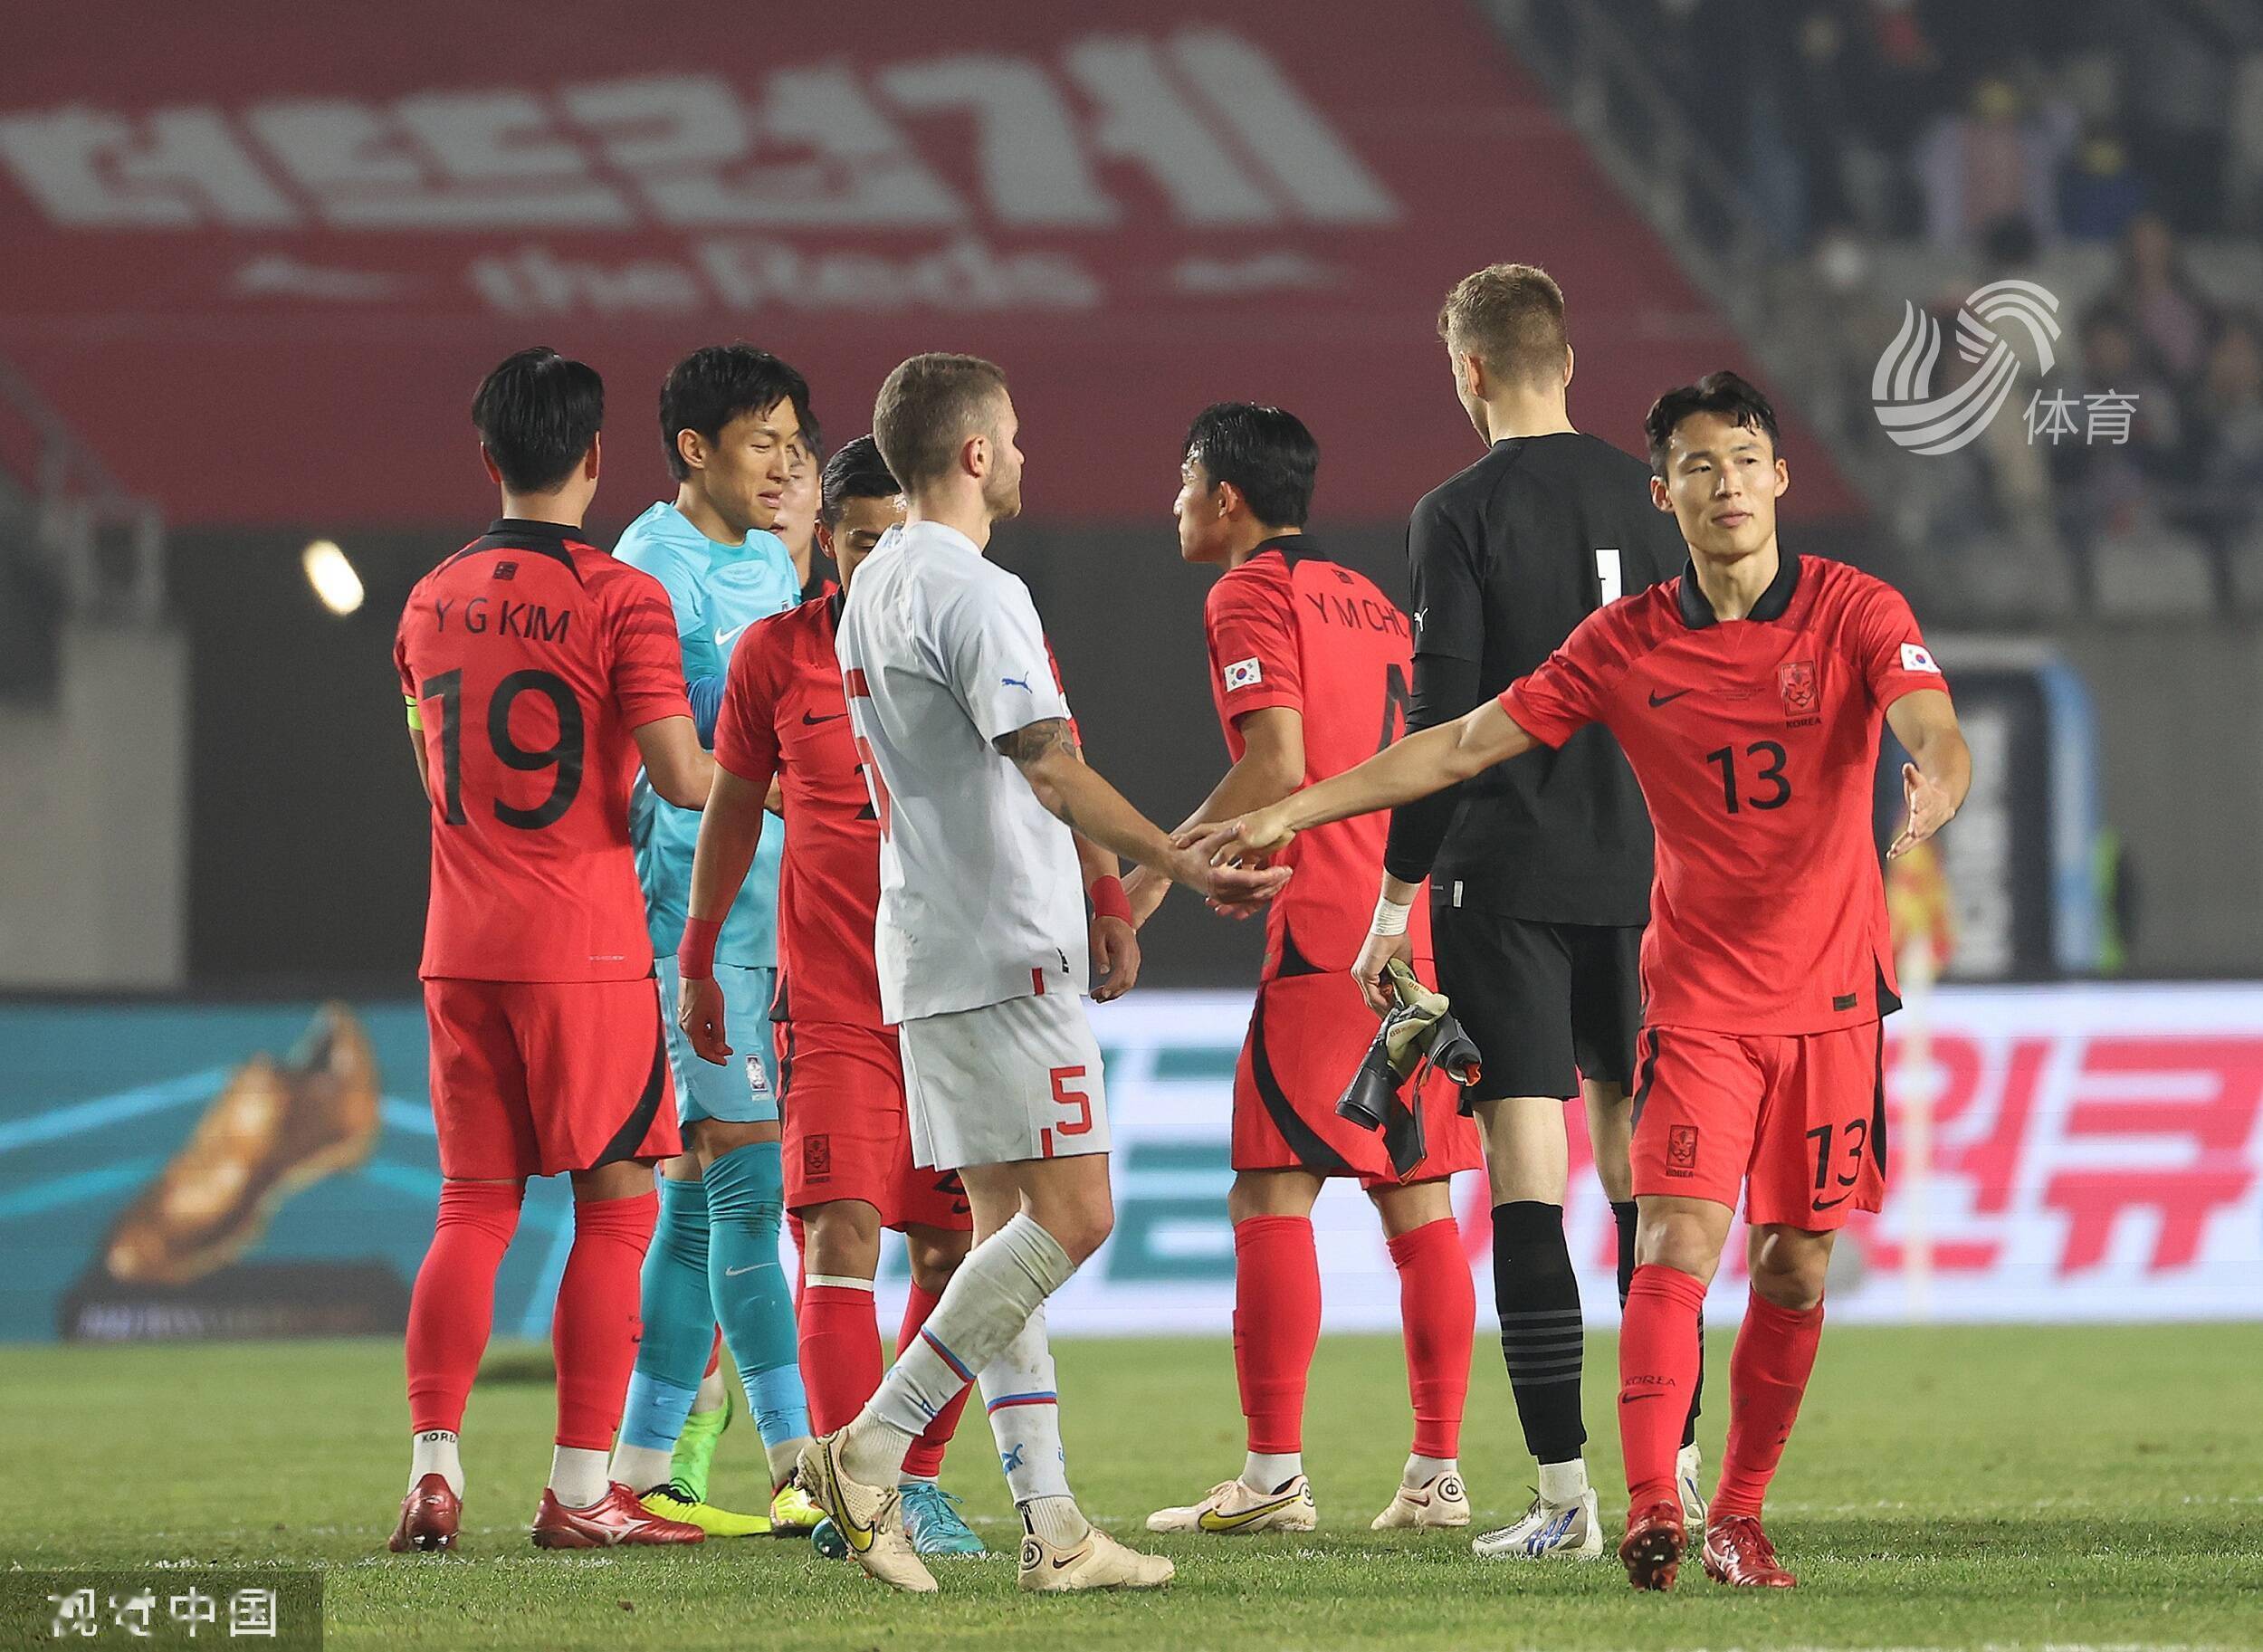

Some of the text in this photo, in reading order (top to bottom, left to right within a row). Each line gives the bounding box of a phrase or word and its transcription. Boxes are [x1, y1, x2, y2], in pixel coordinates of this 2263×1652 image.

[434, 597, 571, 645] Y G KIM
[422, 667, 586, 830] 19
[1785, 717, 1822, 730] KOREA
[1706, 740, 1791, 814] 13
[1049, 1065, 1093, 1136] 5
[1805, 1118, 1867, 1189] 13
[1625, 1375, 1676, 1388] KOREA
